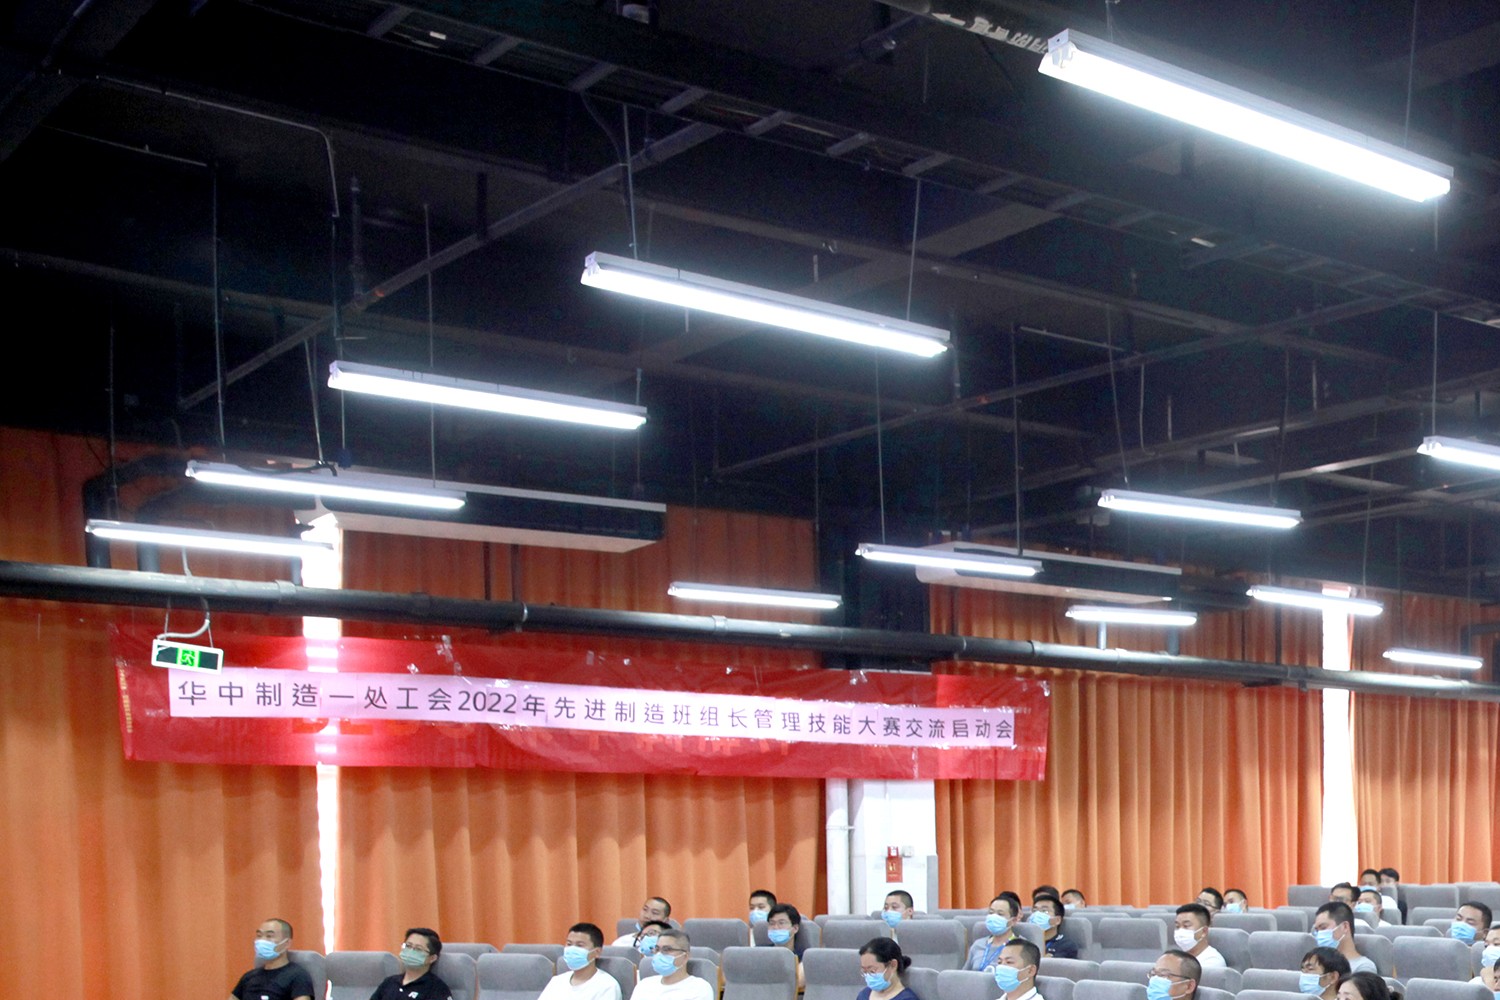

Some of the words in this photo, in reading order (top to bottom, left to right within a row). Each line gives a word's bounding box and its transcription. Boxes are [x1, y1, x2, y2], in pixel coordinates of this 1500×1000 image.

[178, 681, 1013, 739] 华中制造一处工会2022年先进制造班组长管理技能大赛交流启动会
